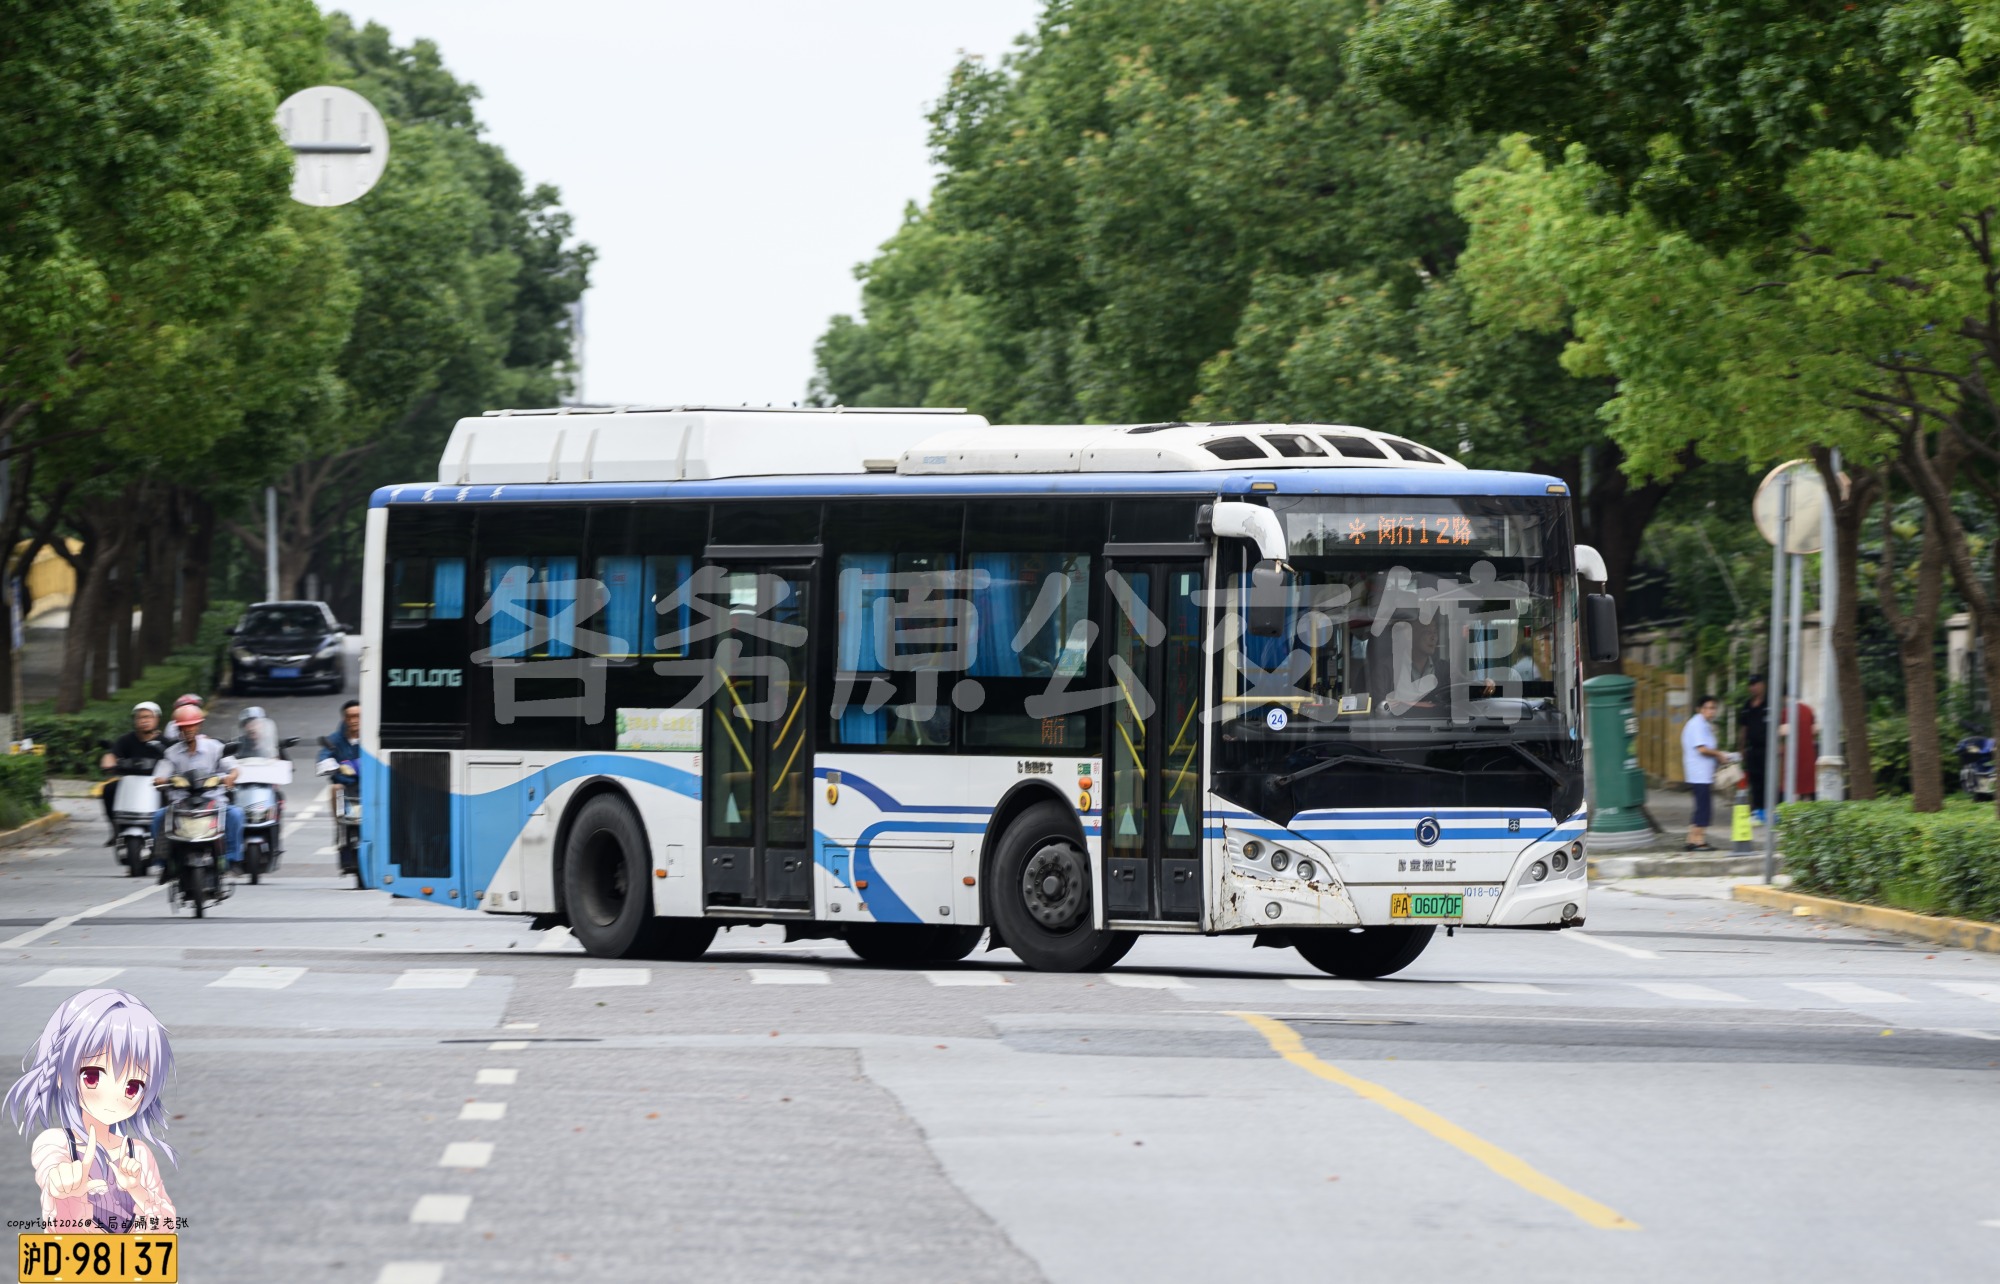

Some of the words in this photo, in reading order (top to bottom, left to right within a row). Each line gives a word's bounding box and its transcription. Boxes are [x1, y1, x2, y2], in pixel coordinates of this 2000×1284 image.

[387, 668, 463, 687] SUNLONG
[1271, 713, 1284, 725] 24
[1463, 887, 1500, 898] JQ18-05
